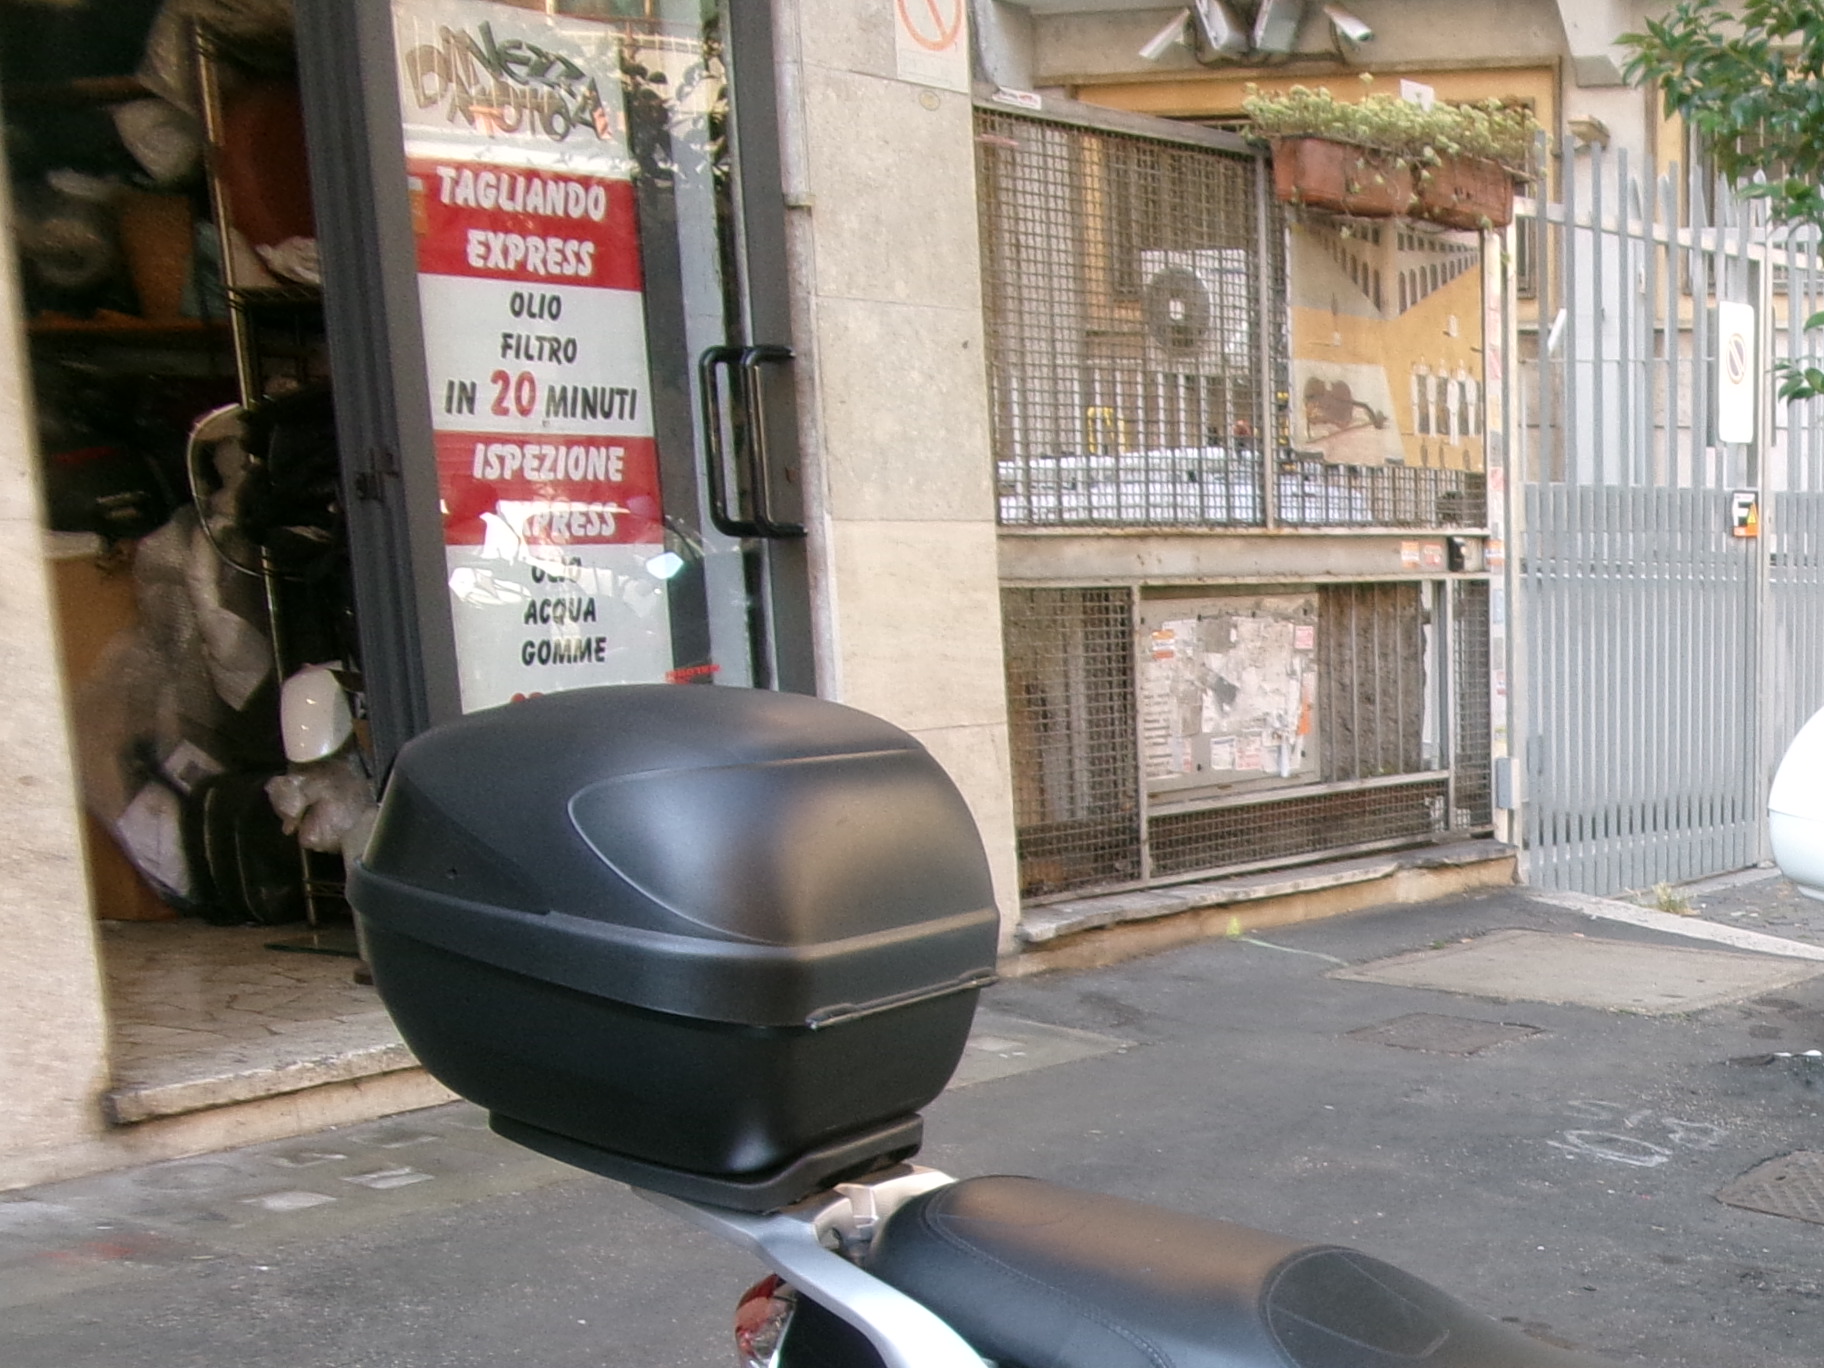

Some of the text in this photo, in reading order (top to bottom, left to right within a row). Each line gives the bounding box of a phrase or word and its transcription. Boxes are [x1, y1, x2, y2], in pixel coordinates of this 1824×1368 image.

[436, 165, 607, 221] TAGLIANDO
[466, 229, 595, 277] EXPRESS
[510, 291, 562, 321] OLIO
[500, 332, 578, 365] FILTRO
[444, 369, 638, 421] IN 20 MINUTI
[472, 442, 625, 483] ISPEZIONE
[500, 501, 616, 537] PRESS
[524, 597, 597, 625] ACQUA
[521, 636, 607, 666] GOMME
